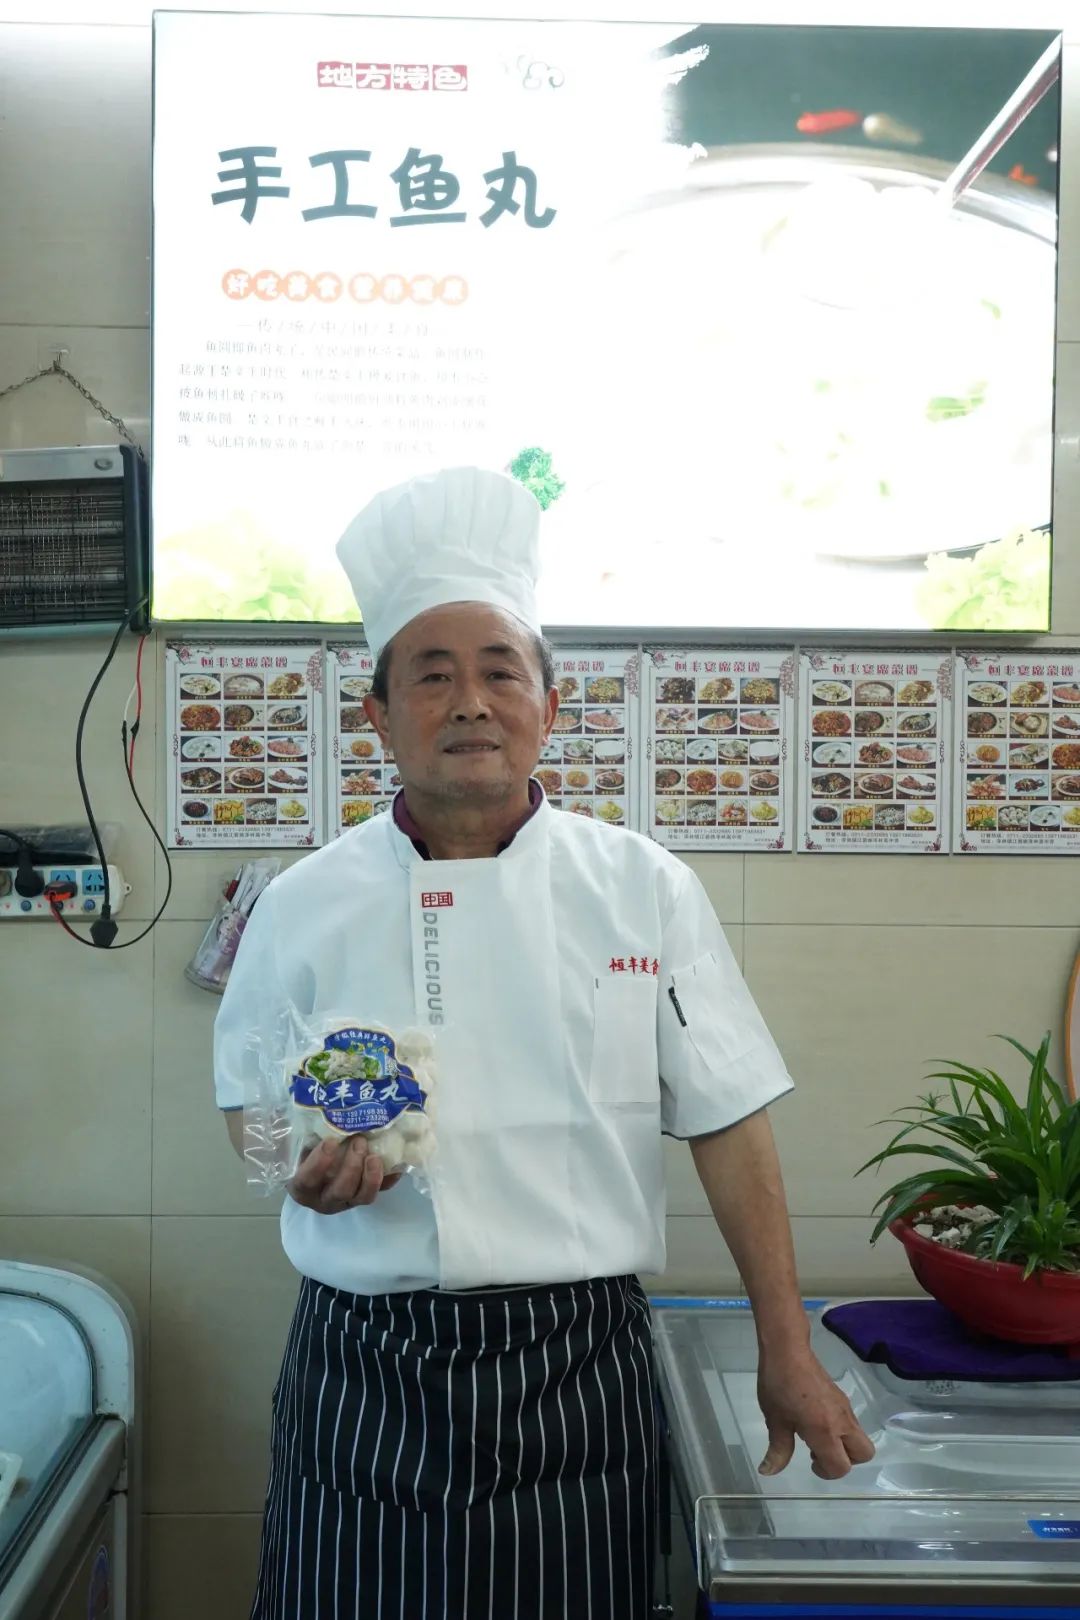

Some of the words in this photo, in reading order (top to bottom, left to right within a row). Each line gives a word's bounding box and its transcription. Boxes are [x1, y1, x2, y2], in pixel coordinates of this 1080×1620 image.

[317, 61, 468, 91] 地方特色
[211, 146, 557, 229] 手工鱼丸
[423, 912, 444, 1025] DELICIOUS
[308, 1080, 409, 1109] 恒丰鱼丸
